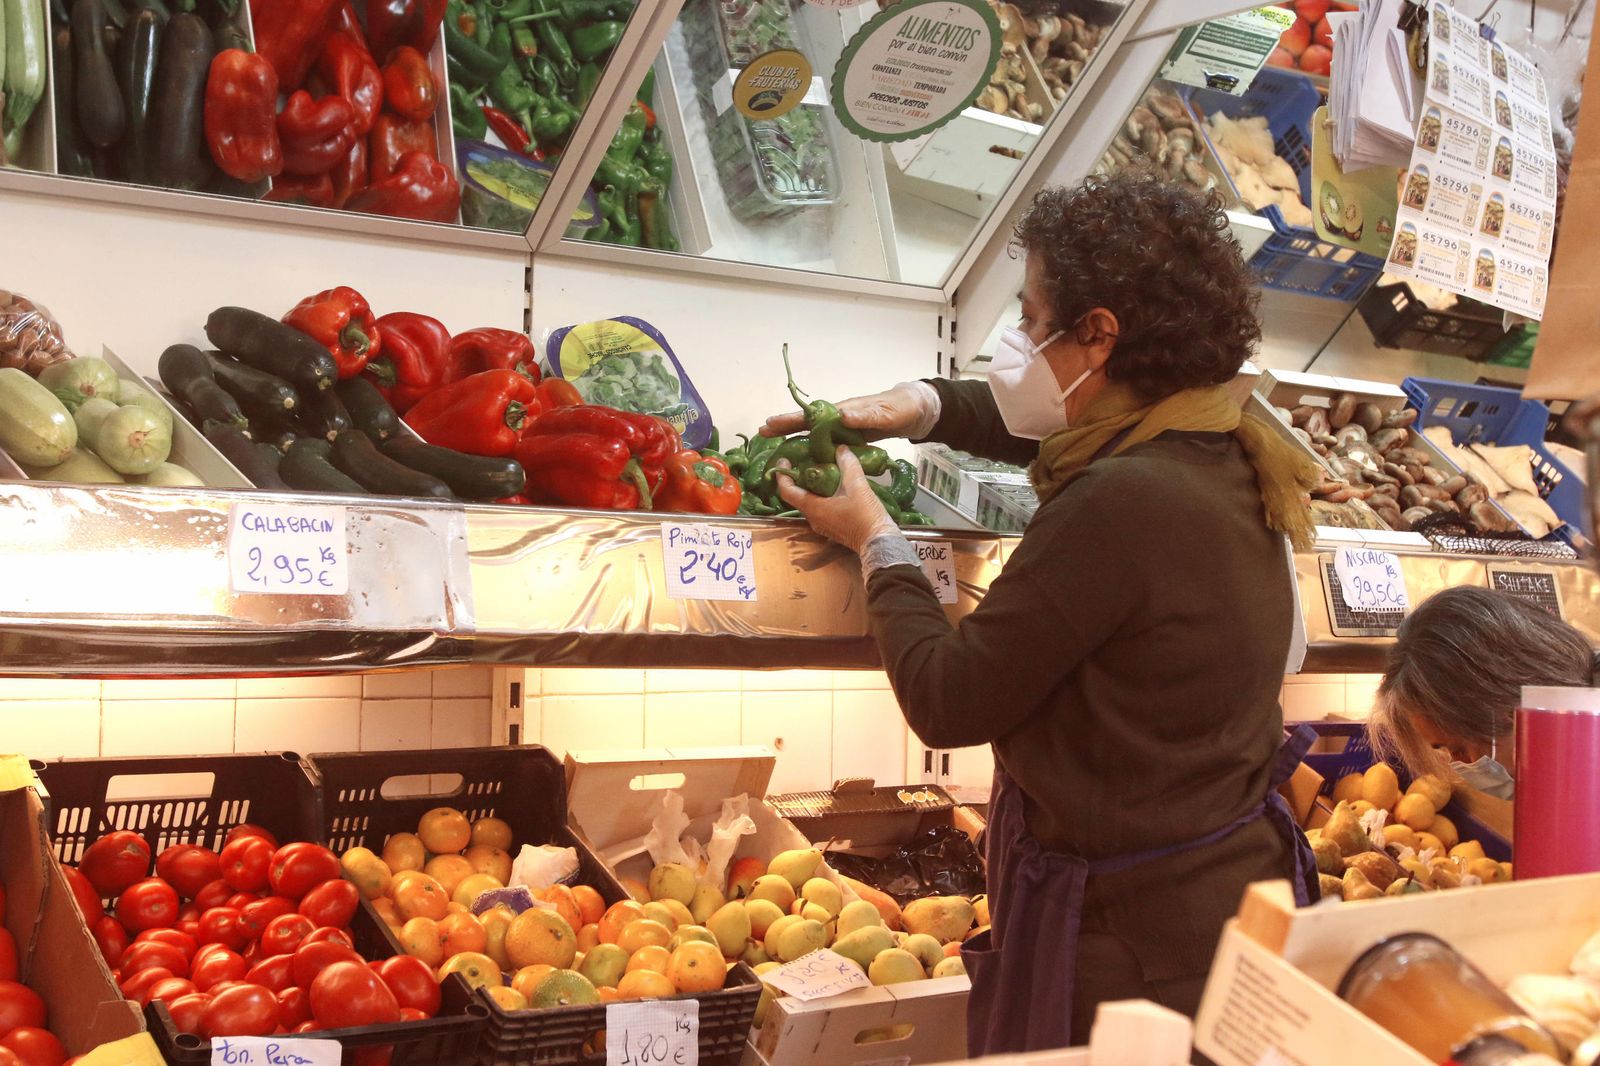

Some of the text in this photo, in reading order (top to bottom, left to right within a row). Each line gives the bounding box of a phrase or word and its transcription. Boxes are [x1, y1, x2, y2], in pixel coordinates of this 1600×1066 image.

[896, 15, 981, 51] ALIMENTOS
[888, 39, 968, 62] por el bien común
[759, 66, 800, 79] CLUB DE
[872, 64, 902, 76] CONFIANZA
[1453, 65, 1481, 87] 45796
[914, 82, 947, 94] TEMPORADA
[855, 100, 873, 110] BIEN
[868, 92, 901, 104] PRECIOS
[900, 99, 929, 110] JUSTOS
[1446, 118, 1479, 137] 45796
[1516, 148, 1545, 167] 45796
[1435, 175, 1469, 194] 45796
[1510, 203, 1541, 221] 45796
[1423, 232, 1457, 250] 45796
[1500, 258, 1533, 276] 45796
[241, 512, 334, 533] CALABACIN
[727, 532, 752, 560] Rojo
[916, 544, 947, 560] ERDE
[247, 546, 313, 586] 2,95
[1345, 549, 1390, 567] NISCALOS
[317, 571, 334, 587] €
[936, 569, 950, 586] Kg
[621, 1028, 668, 1066] 1,80
[674, 1046, 685, 1065] €
